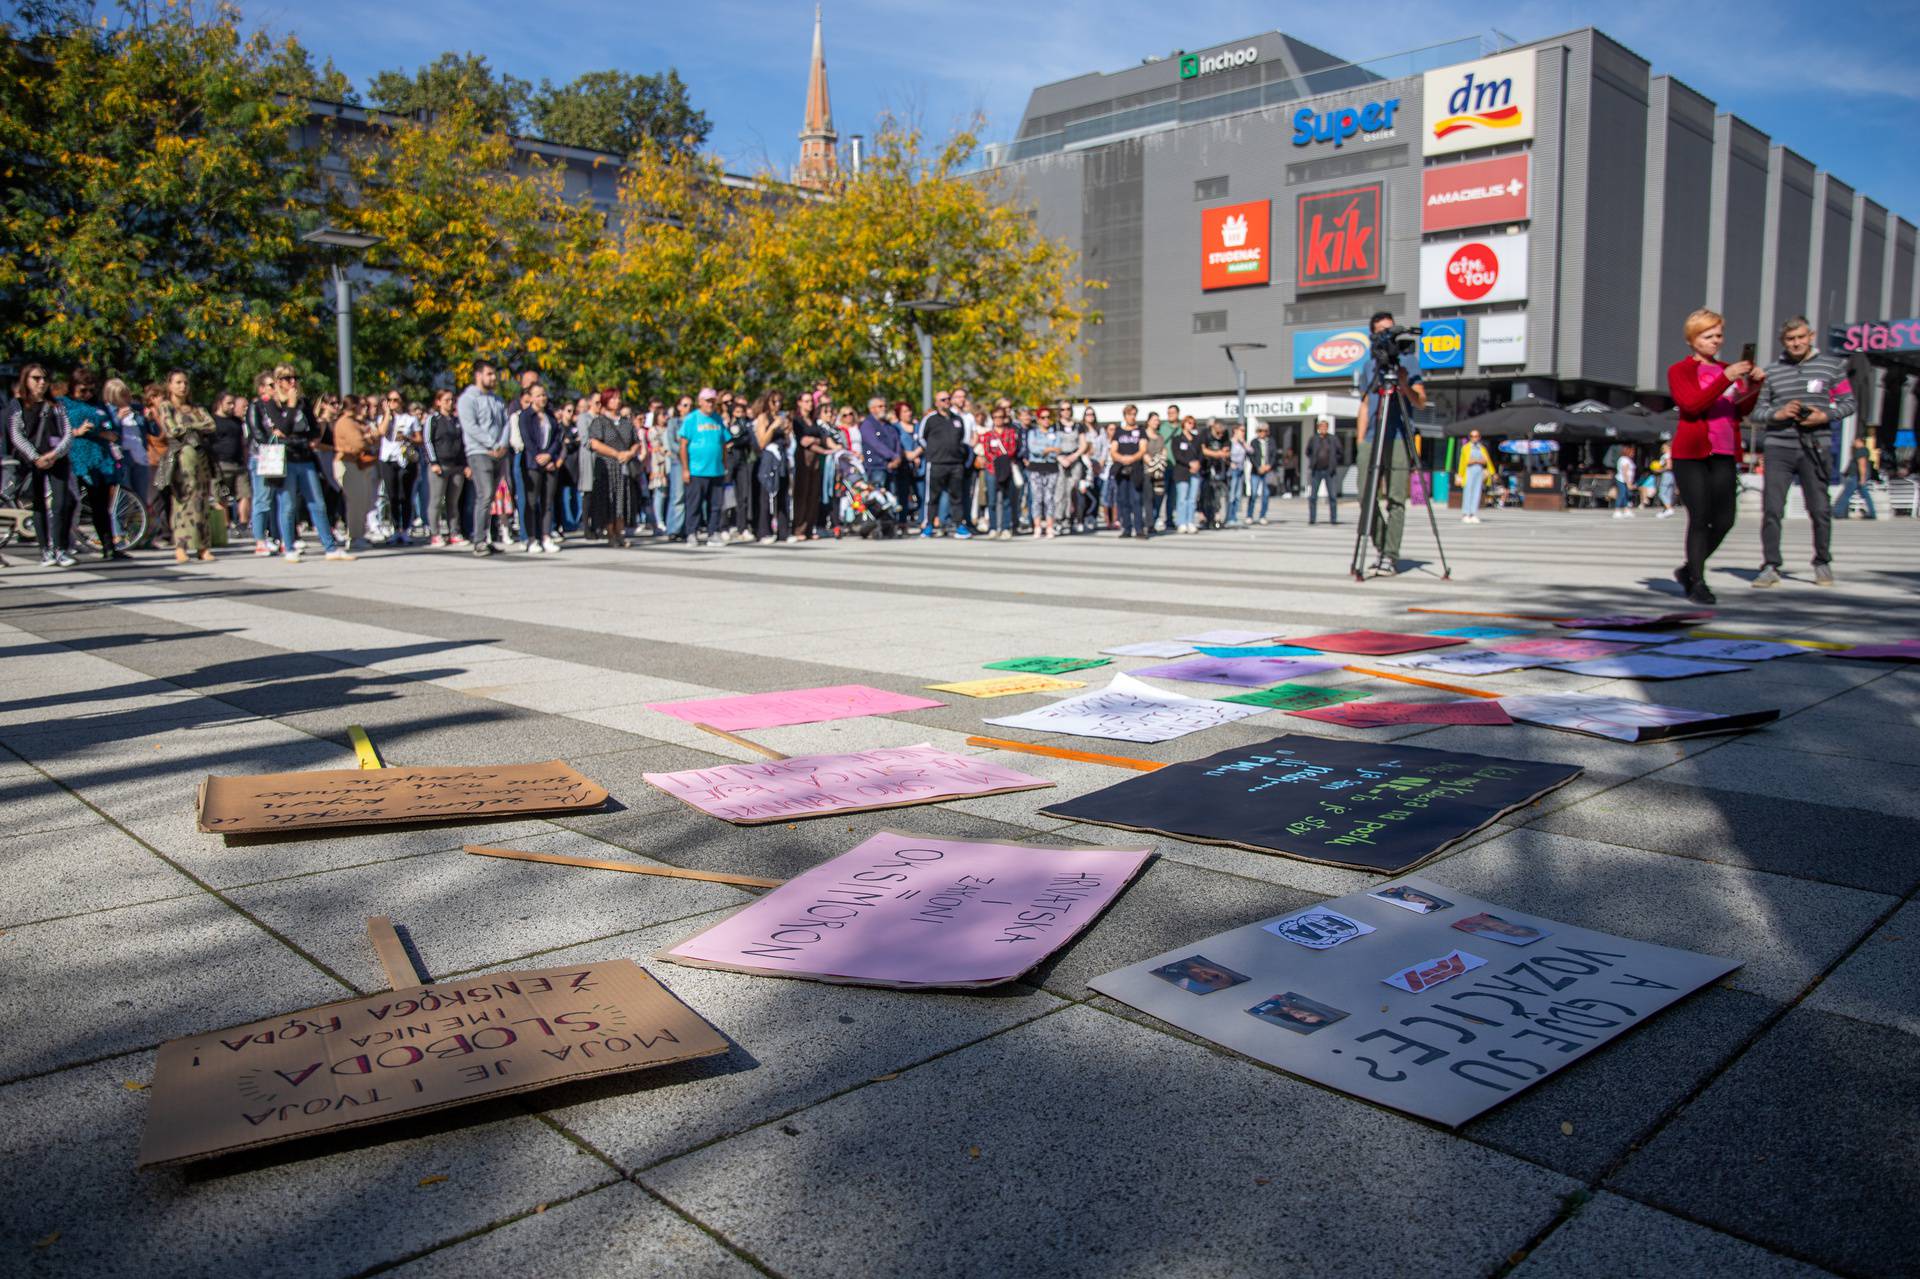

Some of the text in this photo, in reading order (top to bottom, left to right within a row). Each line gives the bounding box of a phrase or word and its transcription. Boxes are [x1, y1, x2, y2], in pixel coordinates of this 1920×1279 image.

[1200, 46, 1258, 75] inchoo
[1448, 73, 1512, 115] dm
[1291, 97, 1400, 147] Super
[1427, 184, 1505, 206] AMADEUS
[1317, 345, 1360, 362] PEPCO
[1225, 397, 1294, 415] famacia
[543, 791, 588, 805] Ne
[1285, 815, 1331, 837] stav
[740, 848, 945, 960] OKSIMORON
[910, 874, 995, 924] ZAKONI
[995, 872, 1104, 943] HRVATSKA
[350, 1008, 507, 1047] IMENICA
[1514, 998, 1638, 1053] GDJE
[273, 1010, 602, 1087] SLOBODA
[1449, 1048, 1547, 1092] SU
[243, 1027, 681, 1126] MOJA JE I TVOJA
